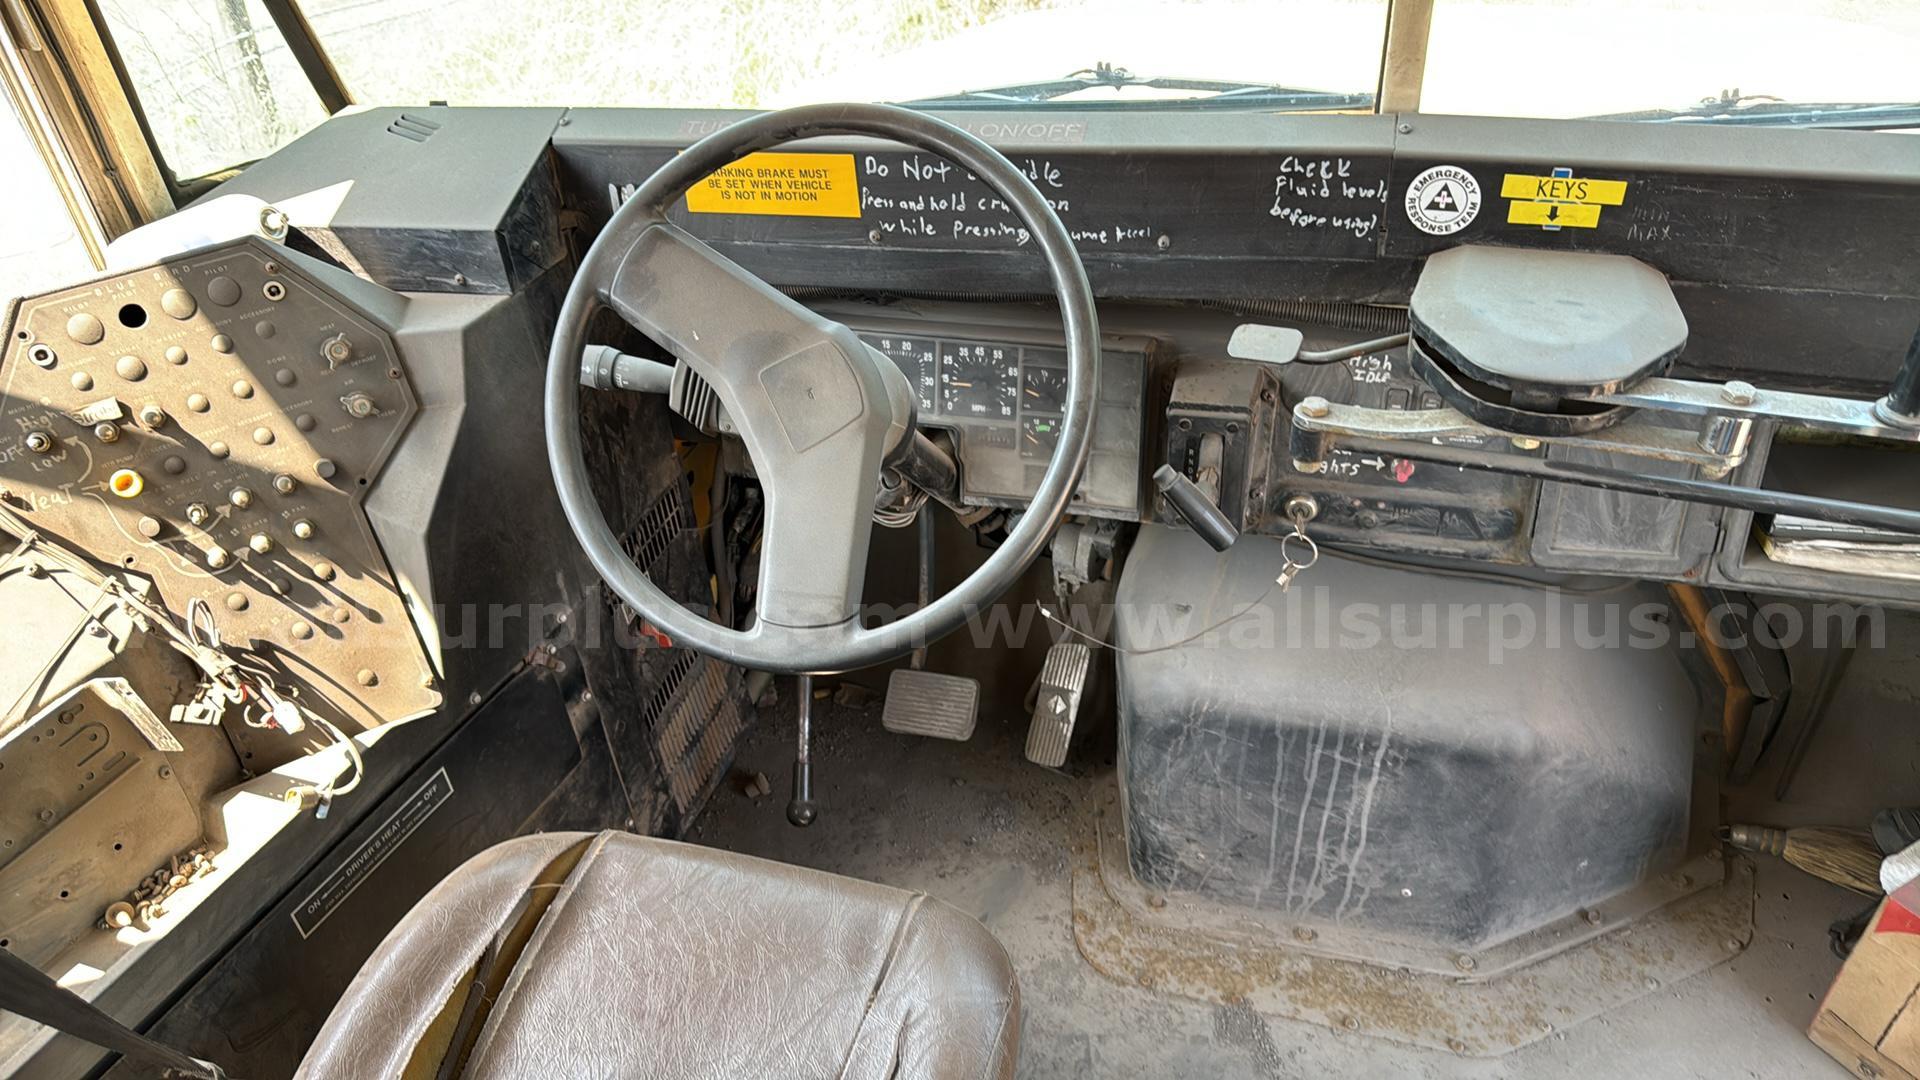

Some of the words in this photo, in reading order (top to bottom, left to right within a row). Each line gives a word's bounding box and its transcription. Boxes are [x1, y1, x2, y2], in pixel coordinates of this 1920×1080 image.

[979, 123, 1082, 138] ON/OFF
[865, 156, 888, 177] Do
[1280, 156, 1351, 179] Check
[758, 168, 795, 178] BRAKE
[799, 169, 829, 179] MUST
[708, 179, 722, 188] BE
[726, 179, 745, 189] SET
[751, 180, 782, 189] WHEN
[786, 180, 832, 190] VEHICLE
[1413, 169, 1478, 195] EMERGENCY
[1275, 175, 1330, 198] Fluid
[1343, 180, 1387, 203] levels
[1536, 179, 1589, 200] KEYS
[721, 190, 731, 200] IS
[735, 191, 756, 200] NOT
[761, 191, 771, 200] IN
[775, 192, 818, 201] MOTION
[900, 195, 925, 212] and
[930, 191, 966, 212] hold
[978, 198, 1010, 213] cru
[1269, 196, 1327, 227] before
[1408, 197, 1452, 233] RESPONSE
[1453, 201, 1478, 228] TEAM
[879, 216, 937, 236] while
[1071, 230, 1108, 243] ume
[94, 279, 136, 297] BLUE
[153, 264, 191, 282] BIRD
[902, 341, 912, 350] 20
[923, 352, 933, 361] 25
[959, 347, 969, 357] 35
[975, 346, 985, 356] 45
[993, 350, 1003, 359] 55
[943, 355, 953, 364] 25
[1008, 367, 1018, 376] 65
[925, 376, 934, 386] 30
[1007, 387, 1017, 396] 75
[922, 399, 931, 408] 35
[971, 404, 986, 412] MPH
[307, 898, 322, 915] ON
[345, 840, 382, 877] DRIVER'S
[381, 820, 402, 842] HEAT
[423, 783, 439, 801] OFF
